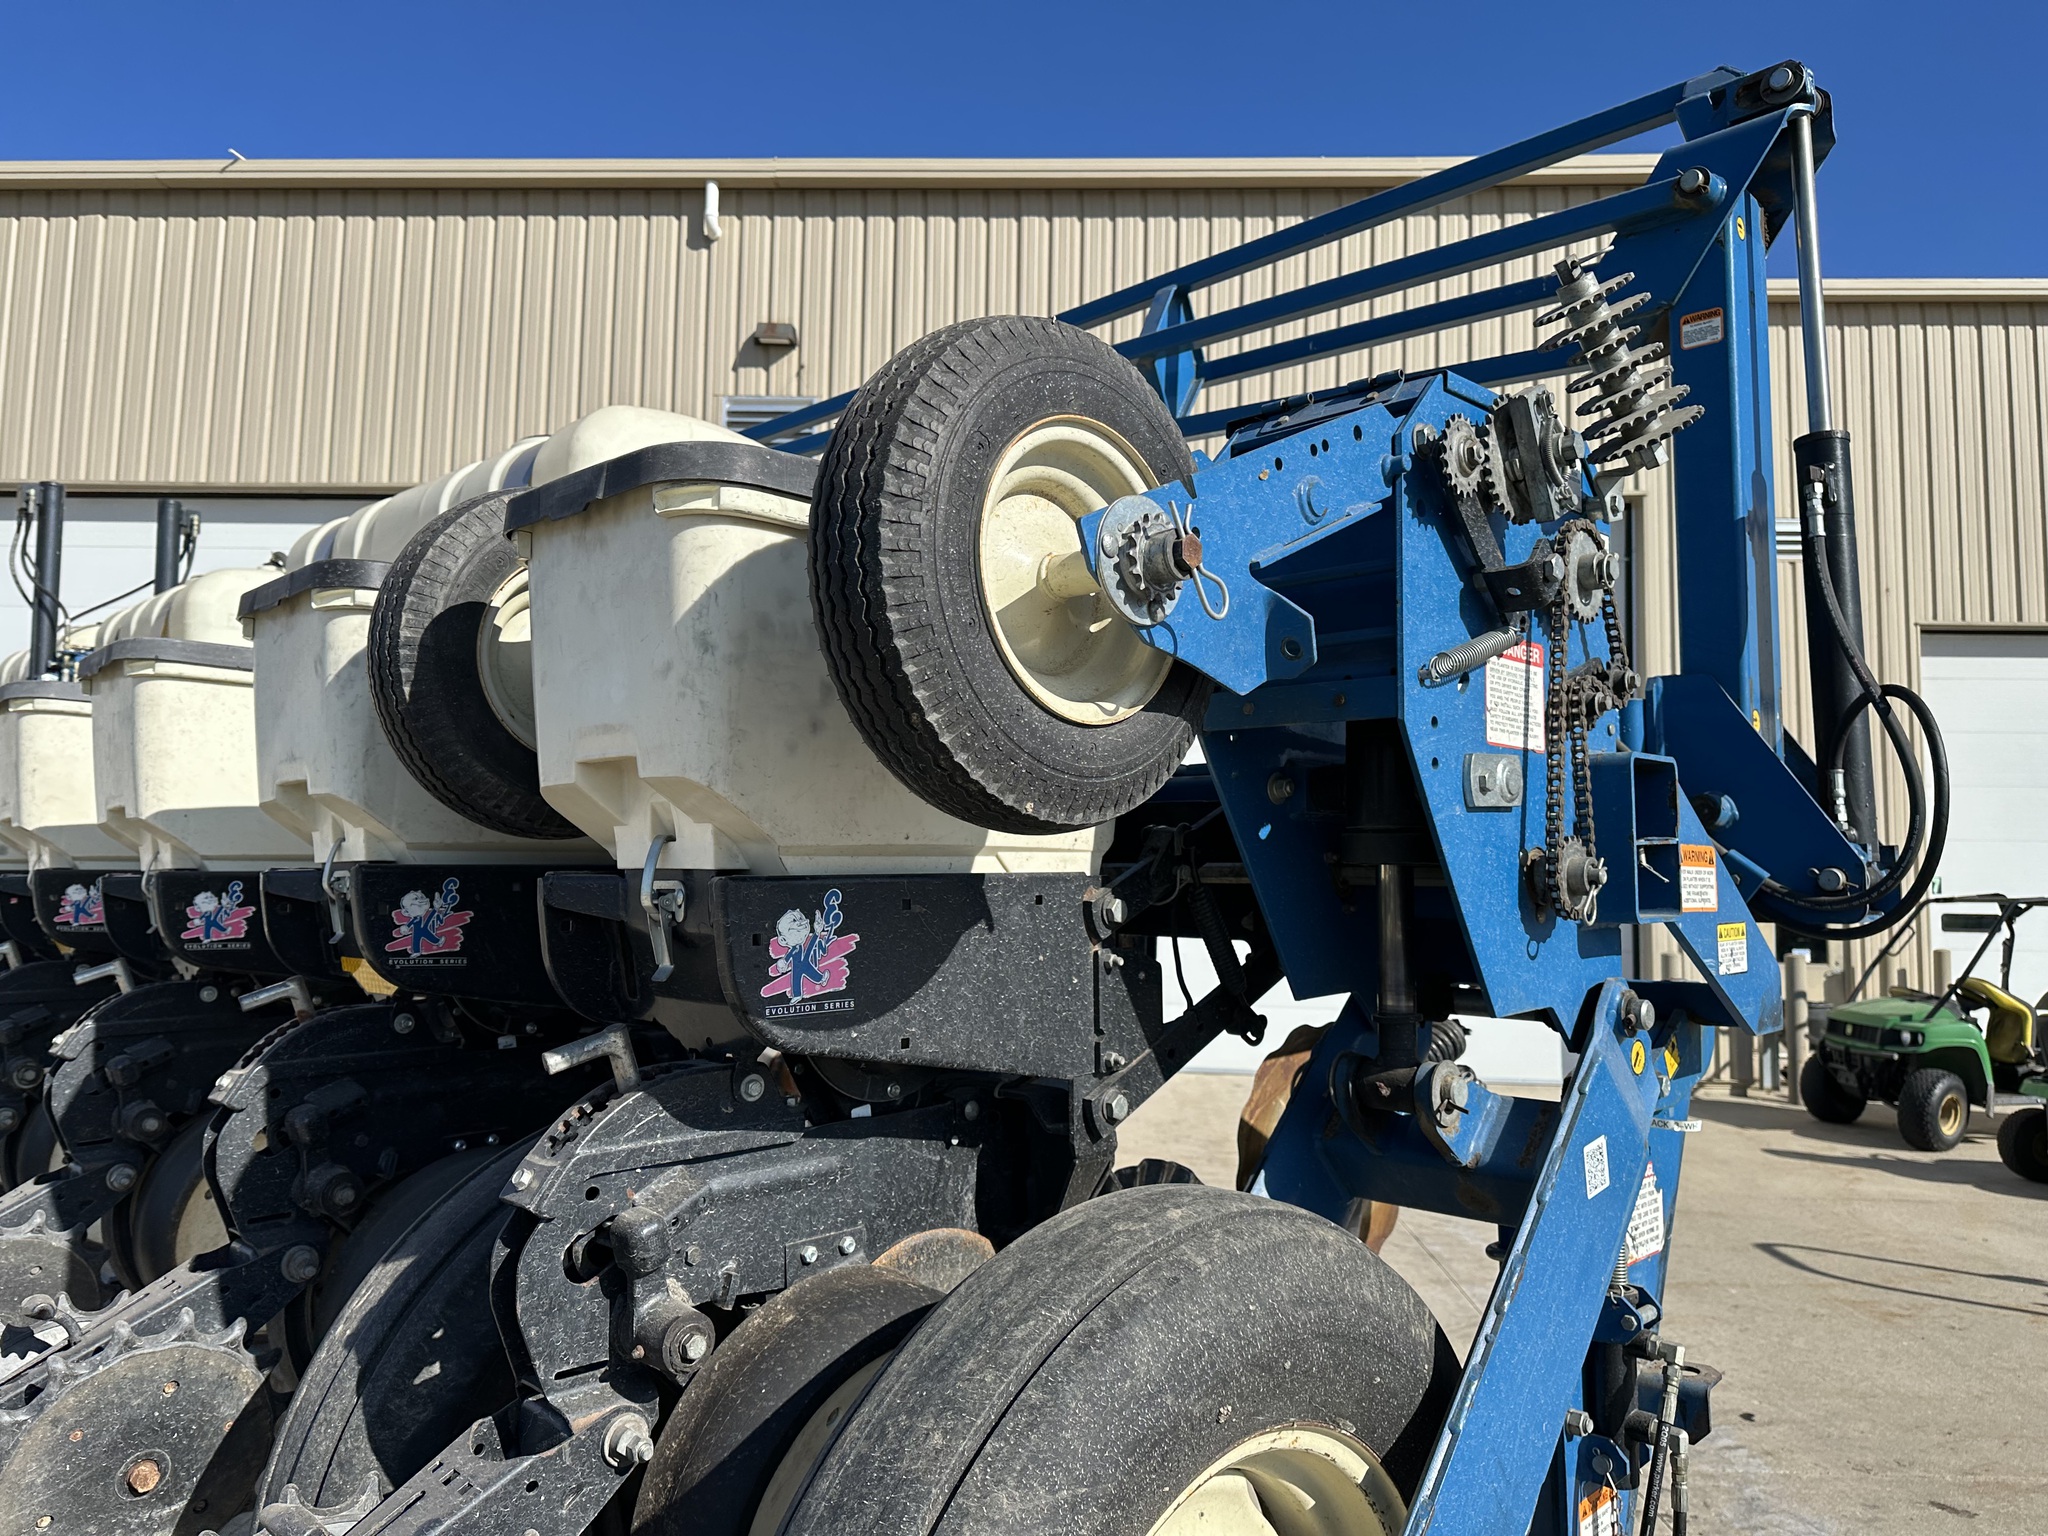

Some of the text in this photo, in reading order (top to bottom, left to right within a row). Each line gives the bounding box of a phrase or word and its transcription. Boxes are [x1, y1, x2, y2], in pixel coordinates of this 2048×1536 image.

[1689, 308, 1721, 323] WARNING
[1682, 848, 1708, 864] WARNING
[1724, 926, 1740, 938] CAUTION
[766, 1000, 855, 1016] EVOLUTION SERIES
[1647, 1453, 1664, 1518] www.parker.com
